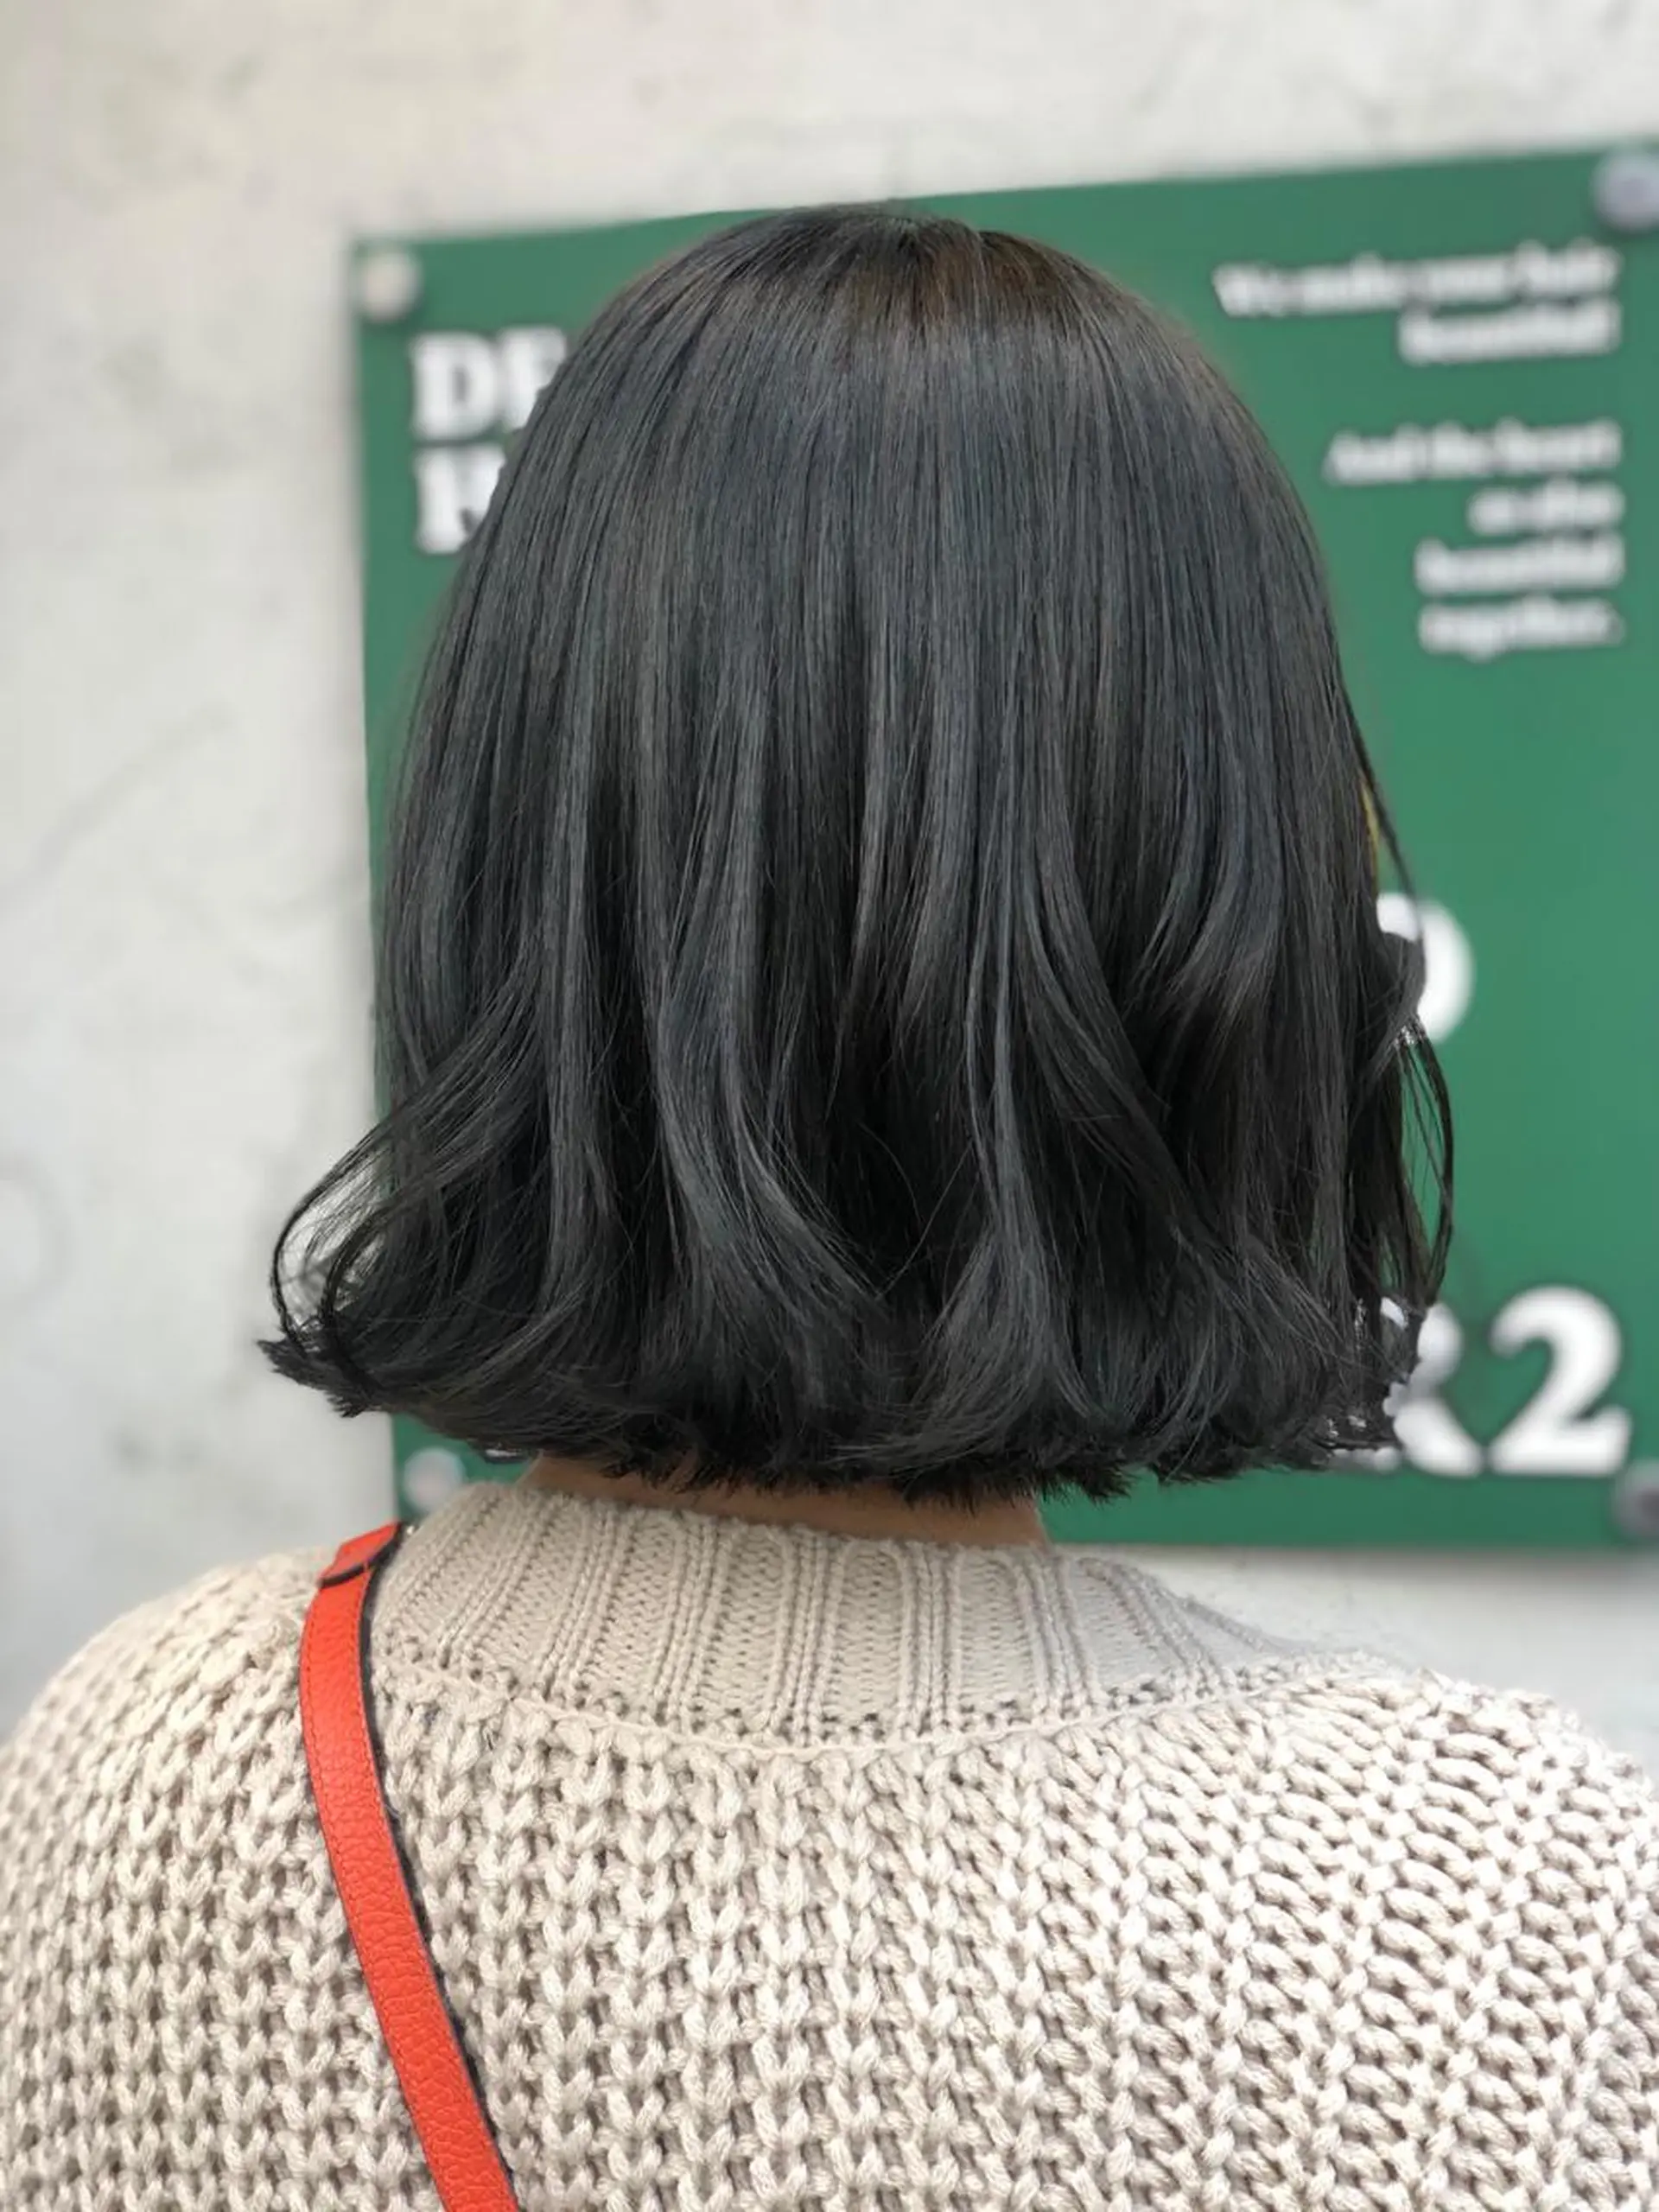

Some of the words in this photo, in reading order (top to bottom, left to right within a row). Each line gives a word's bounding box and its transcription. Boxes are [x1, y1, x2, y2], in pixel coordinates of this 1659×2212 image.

[1213, 263, 1294, 317] We
[1513, 239, 1621, 296] hair
[1324, 423, 1427, 485] And
[1430, 420, 1493, 479] the
[1495, 417, 1622, 475] heart
